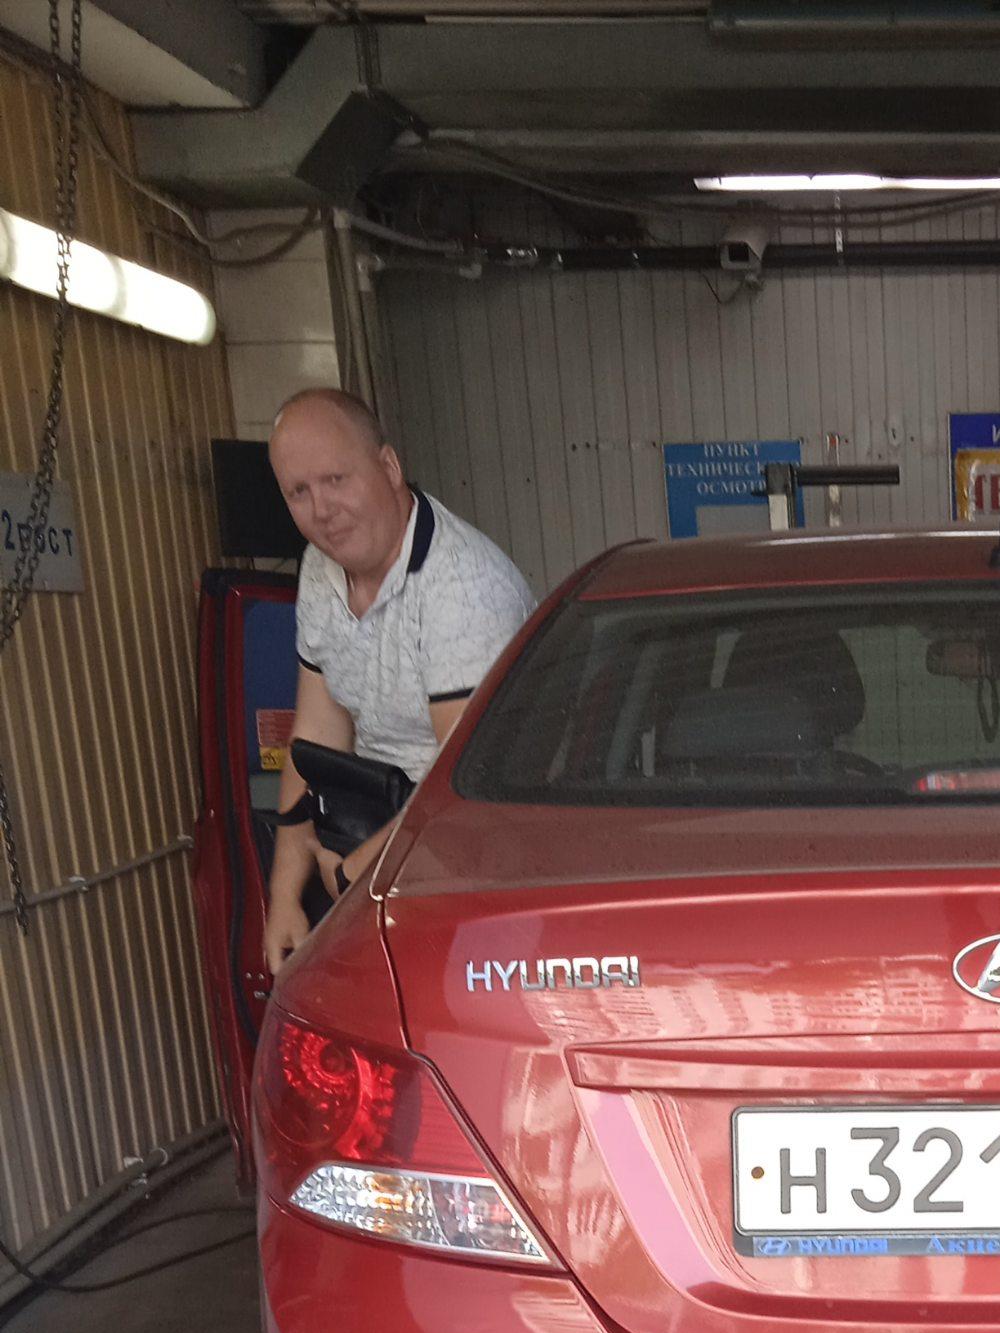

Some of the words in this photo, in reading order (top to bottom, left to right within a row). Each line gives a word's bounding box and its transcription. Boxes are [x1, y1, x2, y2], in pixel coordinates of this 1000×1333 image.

[703, 443, 759, 458] ПУНКТ
[666, 461, 800, 477] ТЕХНИЧЕСК
[696, 480, 768, 495] ОСМОТР
[2, 509, 15, 550] 2
[466, 956, 641, 992] HYUNDAI
